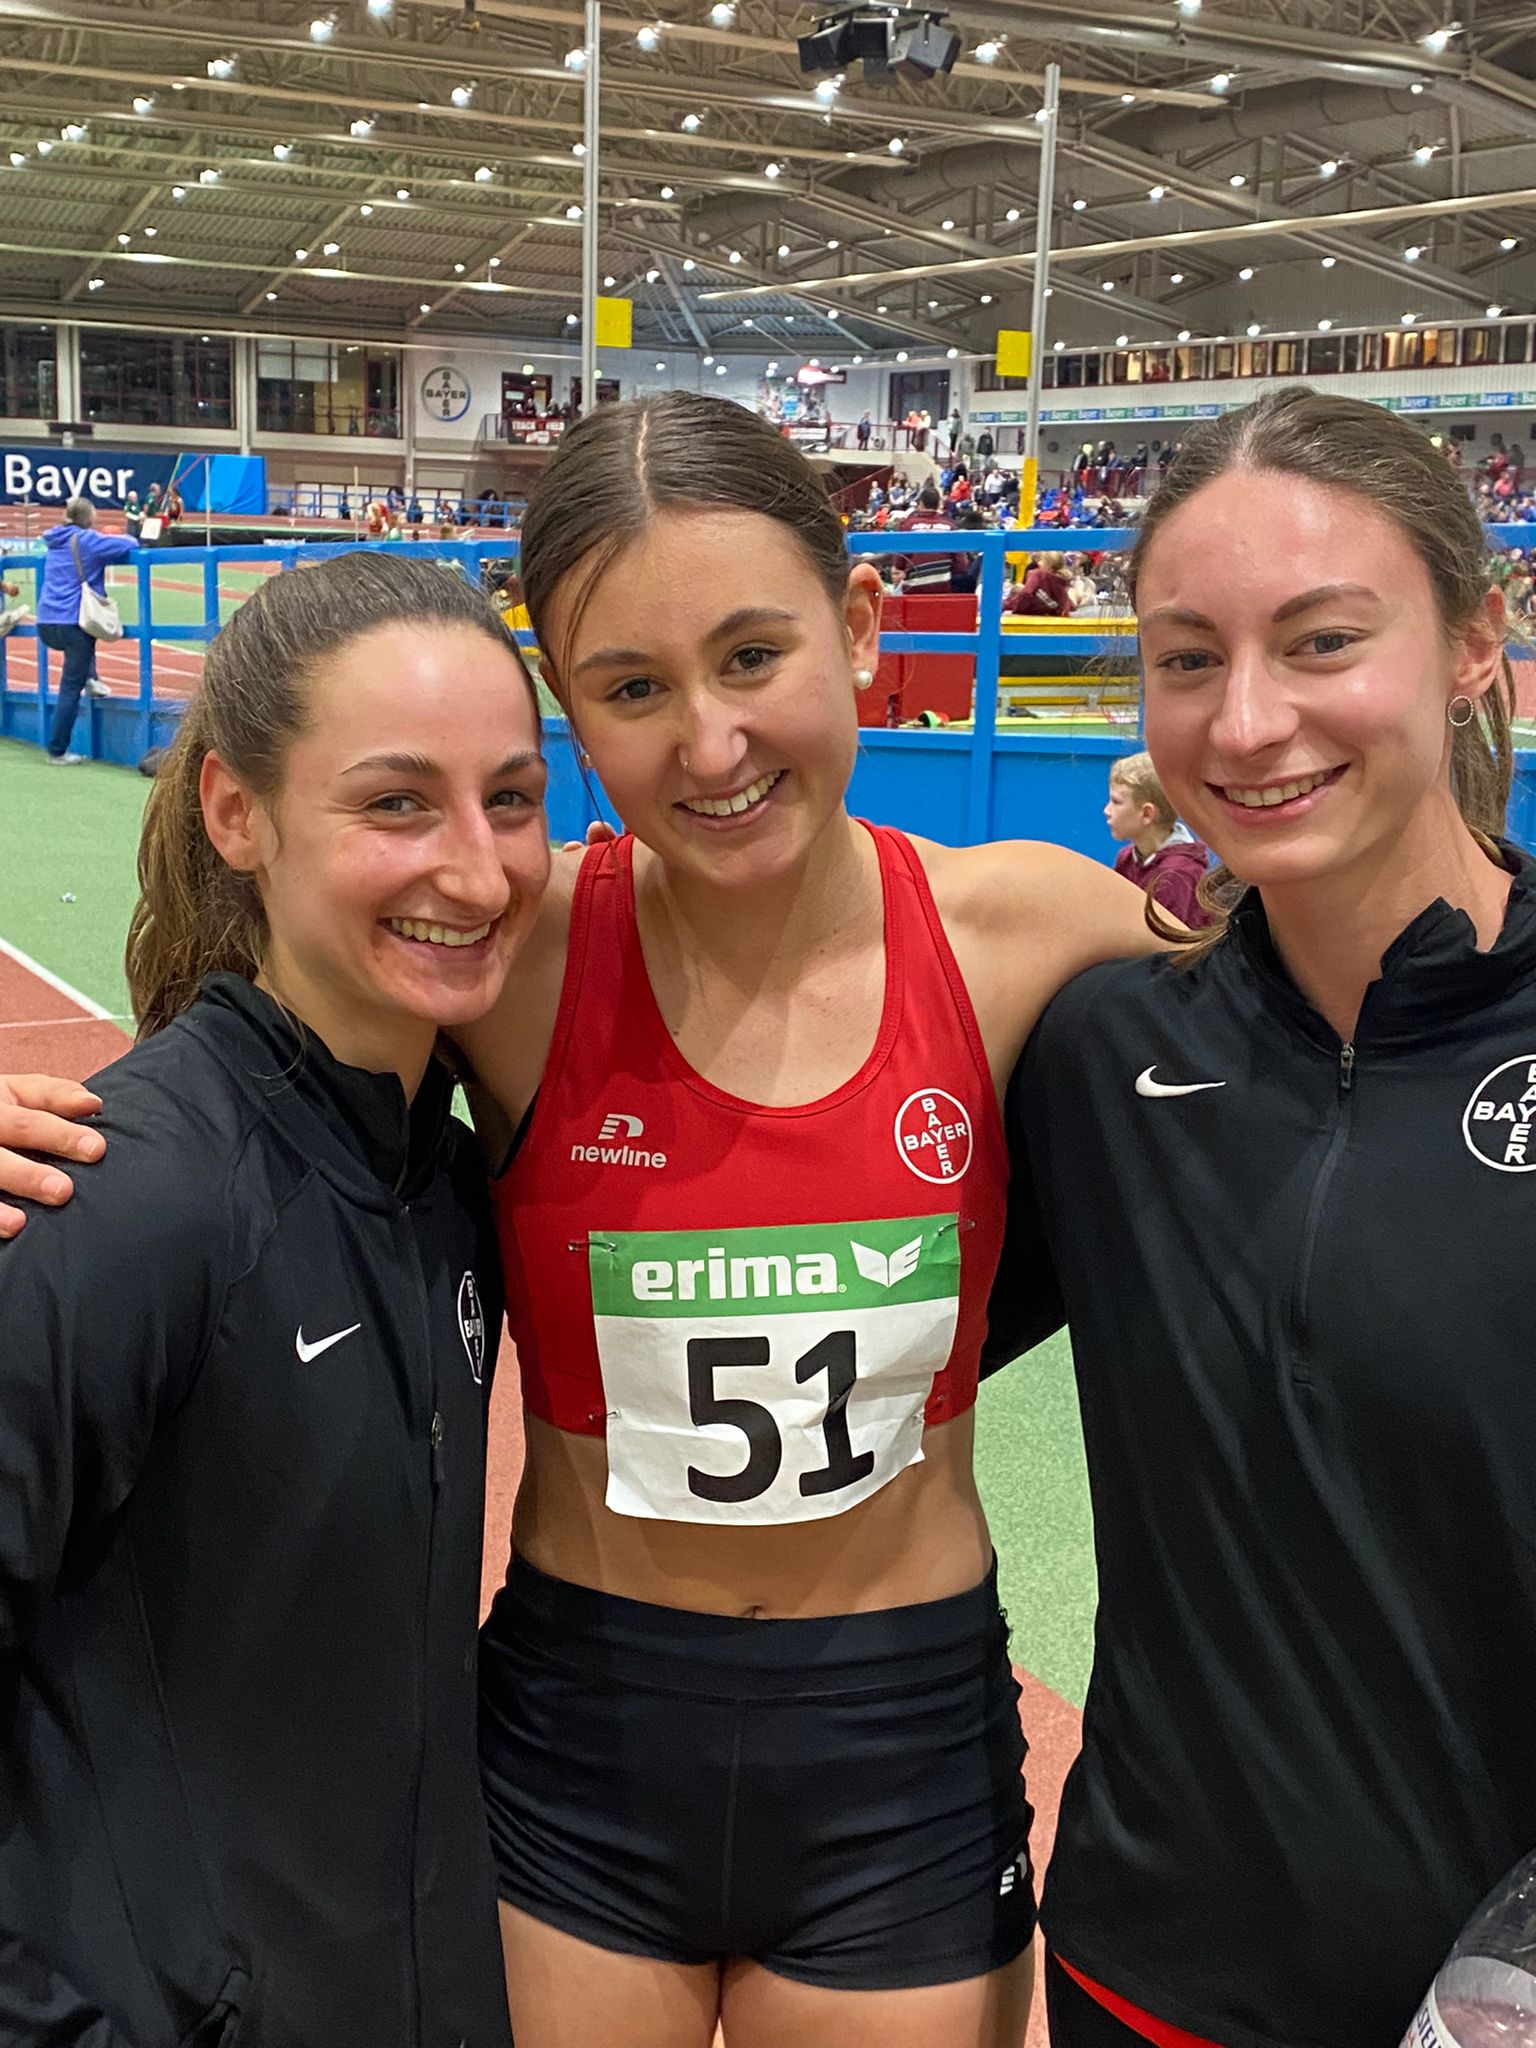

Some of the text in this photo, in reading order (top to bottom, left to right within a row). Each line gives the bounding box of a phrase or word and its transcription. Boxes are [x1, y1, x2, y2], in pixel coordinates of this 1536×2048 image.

[426, 389, 466, 399] BAYER
[1480, 393, 1508, 406] Bayer
[5, 454, 134, 503] Bayer
[903, 1122, 967, 1151] BAYER
[921, 1097, 955, 1176] BAYER
[570, 1144, 667, 1169] newline
[687, 1330, 875, 1503] 51
